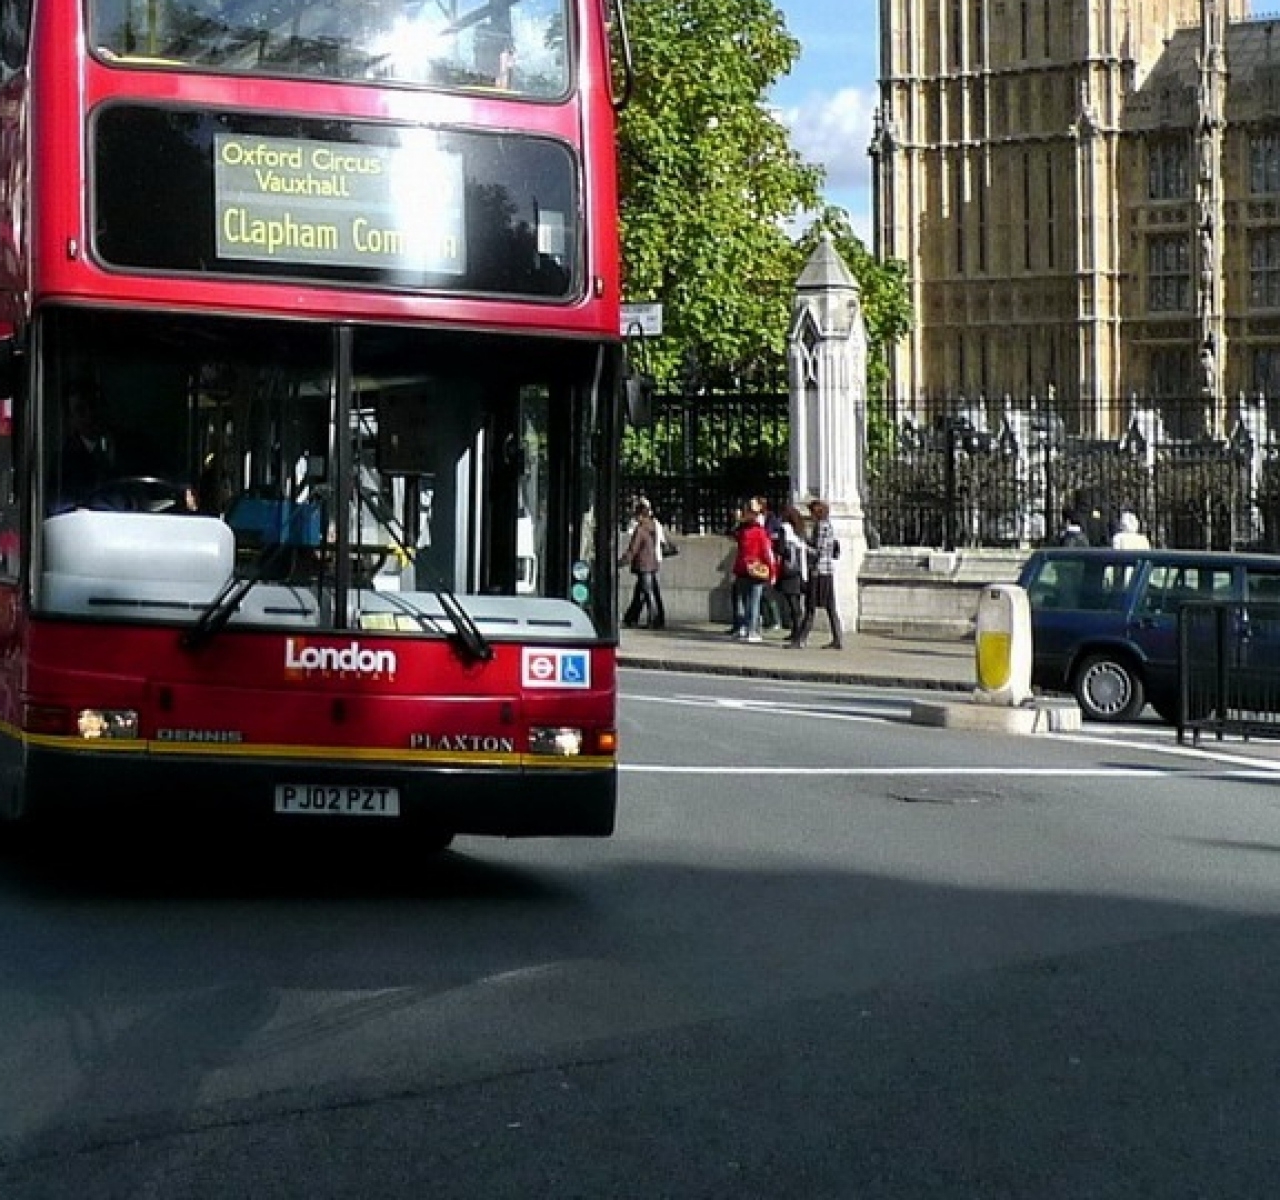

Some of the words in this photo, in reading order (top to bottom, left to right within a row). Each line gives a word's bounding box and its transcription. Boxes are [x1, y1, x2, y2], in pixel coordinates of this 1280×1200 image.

[221, 143, 302, 168] Oxford
[312, 148, 381, 174] Circus
[255, 169, 349, 197] Vauxhall
[223, 208, 338, 253] Clapham
[352, 216, 456, 258] Comn
[285, 637, 397, 673] London
[410, 732, 514, 752] PLAXTON
[282, 786, 341, 809] PJ02
[346, 788, 389, 810] PZT
